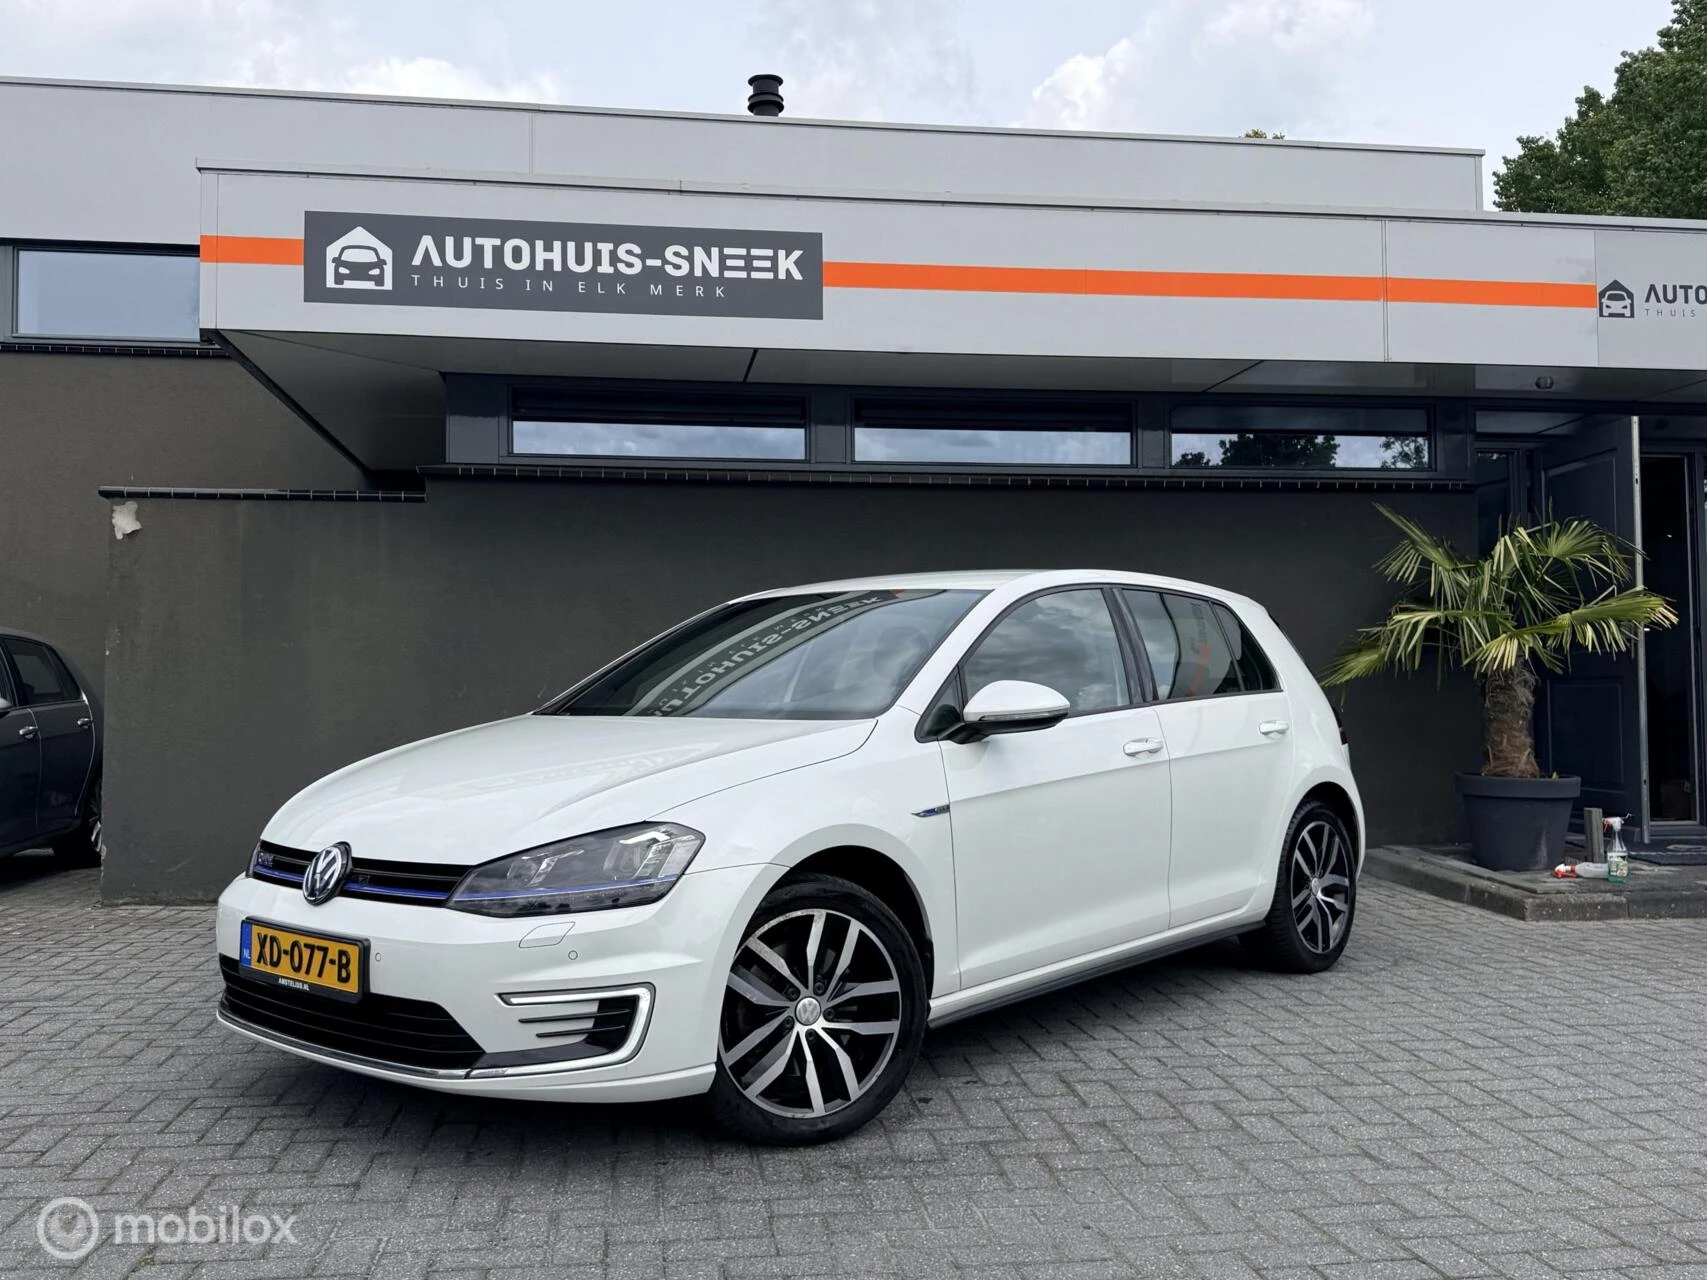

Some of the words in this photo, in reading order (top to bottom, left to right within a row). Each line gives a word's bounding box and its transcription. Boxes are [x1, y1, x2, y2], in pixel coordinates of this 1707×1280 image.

[411, 234, 804, 281] AUTOHUIS-SNEEK
[411, 274, 504, 290] THUIS
[525, 279, 553, 292] IN
[578, 281, 626, 295] ELK
[650, 284, 725, 298] MERK
[1644, 283, 1707, 304] AUTO
[1644, 308, 1697, 318] THUIS
[243, 948, 251, 959] NL
[256, 932, 351, 984] XD-077-B
